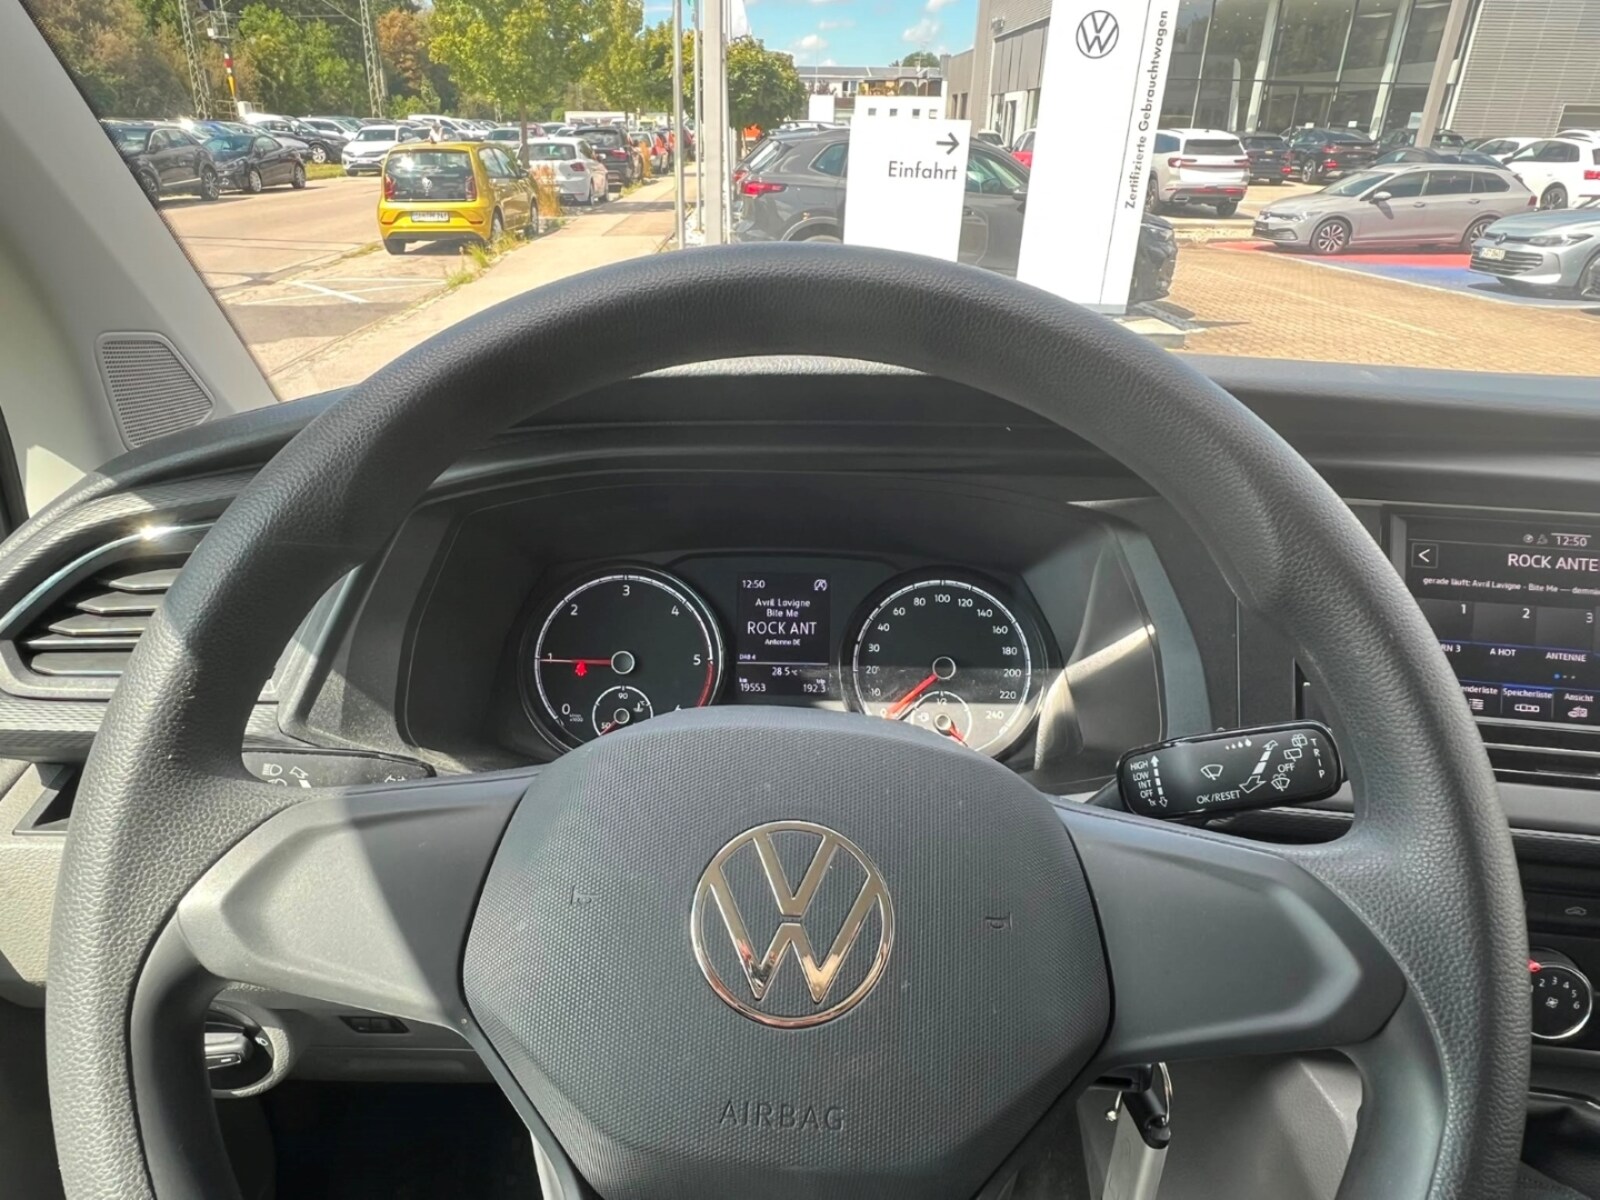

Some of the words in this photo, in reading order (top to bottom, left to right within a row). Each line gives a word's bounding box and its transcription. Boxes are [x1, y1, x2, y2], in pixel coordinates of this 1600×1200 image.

[1125, 136, 1146, 209] Zertifizierte
[1138, 11, 1168, 131] Gebrauchtwagen
[888, 160, 958, 180] Einfahrt
[1556, 537, 1588, 547] 12:50
[1508, 553, 1551, 569] ROCK
[742, 579, 766, 589] 12:50
[1423, 577, 1449, 585] gerade
[1472, 580, 1490, 588] Avril
[1491, 581, 1521, 591] Lavigne
[1528, 583, 1544, 591] Bite
[1546, 584, 1558, 592] Me
[622, 584, 631, 596] 3
[777, 598, 811, 609] Lavigne
[913, 597, 926, 606] 80
[934, 594, 950, 603] 100
[958, 598, 973, 607] 120
[570, 604, 579, 616] 2
[671, 605, 680, 617] 4
[766, 608, 784, 618] Bite
[786, 608, 799, 618] Me
[893, 607, 906, 616] 60
[977, 609, 993, 618] 140
[1461, 604, 1467, 614] 1
[1522, 608, 1530, 619] 2
[1586, 612, 1593, 624] 3
[747, 620, 786, 635] ROCK
[789, 621, 817, 635] ANT
[877, 622, 890, 632] 40
[992, 625, 1009, 635] 160
[868, 643, 880, 653] 30
[1002, 646, 1018, 656] 180
[1455, 644, 1461, 653] 3
[1489, 648, 1496, 656] A
[1498, 648, 1517, 657] HOT
[693, 653, 702, 666] 5
[1545, 652, 1587, 662] ANTENNE
[866, 665, 877, 675] 20
[1003, 668, 1022, 678] 200
[741, 682, 767, 692] 19553
[1460, 685, 1499, 696] enderliste
[618, 692, 629, 700] 90
[871, 688, 881, 697] 10
[1000, 690, 1017, 700] 220
[1503, 687, 1553, 700] Speicherliste
[1564, 692, 1594, 703] Ansicht
[936, 698, 948, 706] 1/2
[561, 703, 571, 715] 0
[986, 710, 1005, 720] 240
[1130, 760, 1149, 771] HIGH
[1278, 763, 1295, 773] OFF
[1132, 771, 1149, 781] LOW
[1138, 779, 1151, 789] INT
[1140, 789, 1153, 798] OFF
[1196, 790, 1241, 804] OK/RESET
[1539, 978, 1545, 987] 2
[1551, 976, 1558, 985] 3
[1562, 981, 1569, 989] 4
[1571, 989, 1577, 998] 5
[1573, 1001, 1580, 1009] 6
[719, 1100, 846, 1132] AIRBAG
